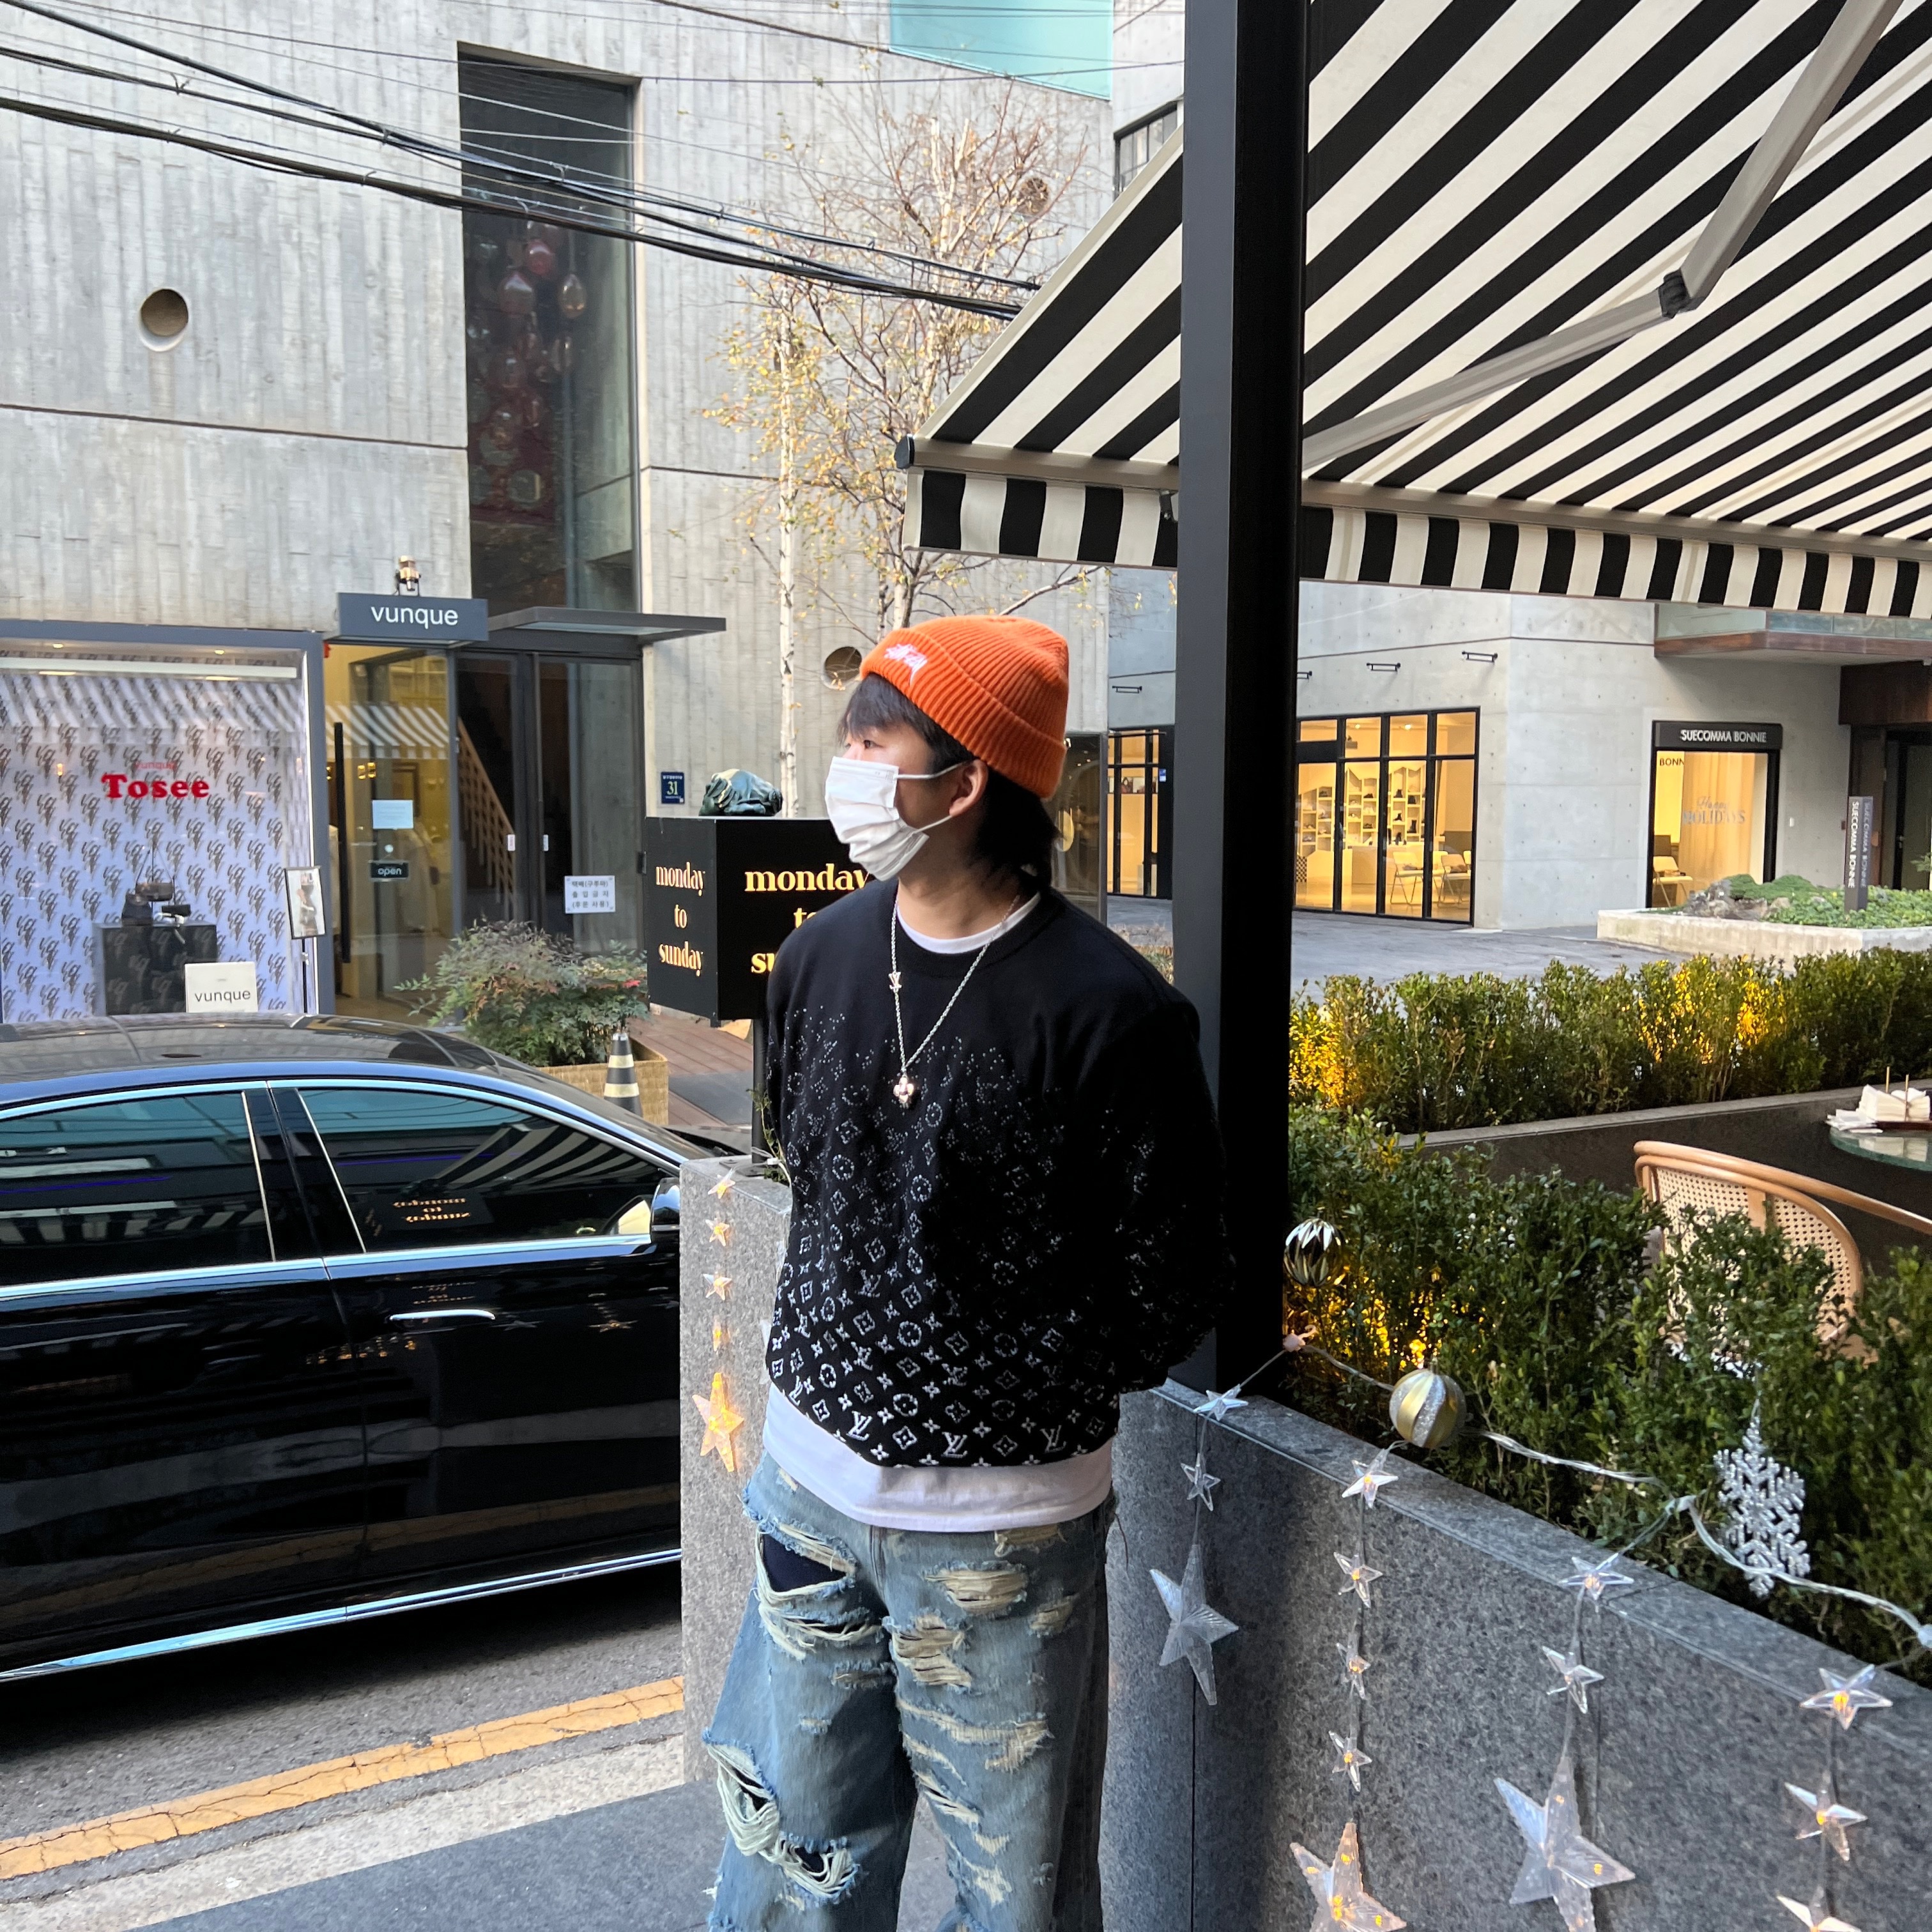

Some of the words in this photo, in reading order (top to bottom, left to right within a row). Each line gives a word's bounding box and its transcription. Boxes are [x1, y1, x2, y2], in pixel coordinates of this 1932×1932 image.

[371, 606, 459, 629] vunque
[1680, 730, 1732, 742] SUECOMMA
[1734, 731, 1767, 742] BONNIE
[101, 773, 210, 799] Tosee
[667, 781, 678, 795] 31
[378, 868, 402, 877] open
[656, 861, 705, 896] monday
[674, 904, 687, 928] to
[793, 908, 816, 928] t
[658, 940, 703, 977] sunday
[194, 990, 251, 1004] vunque
